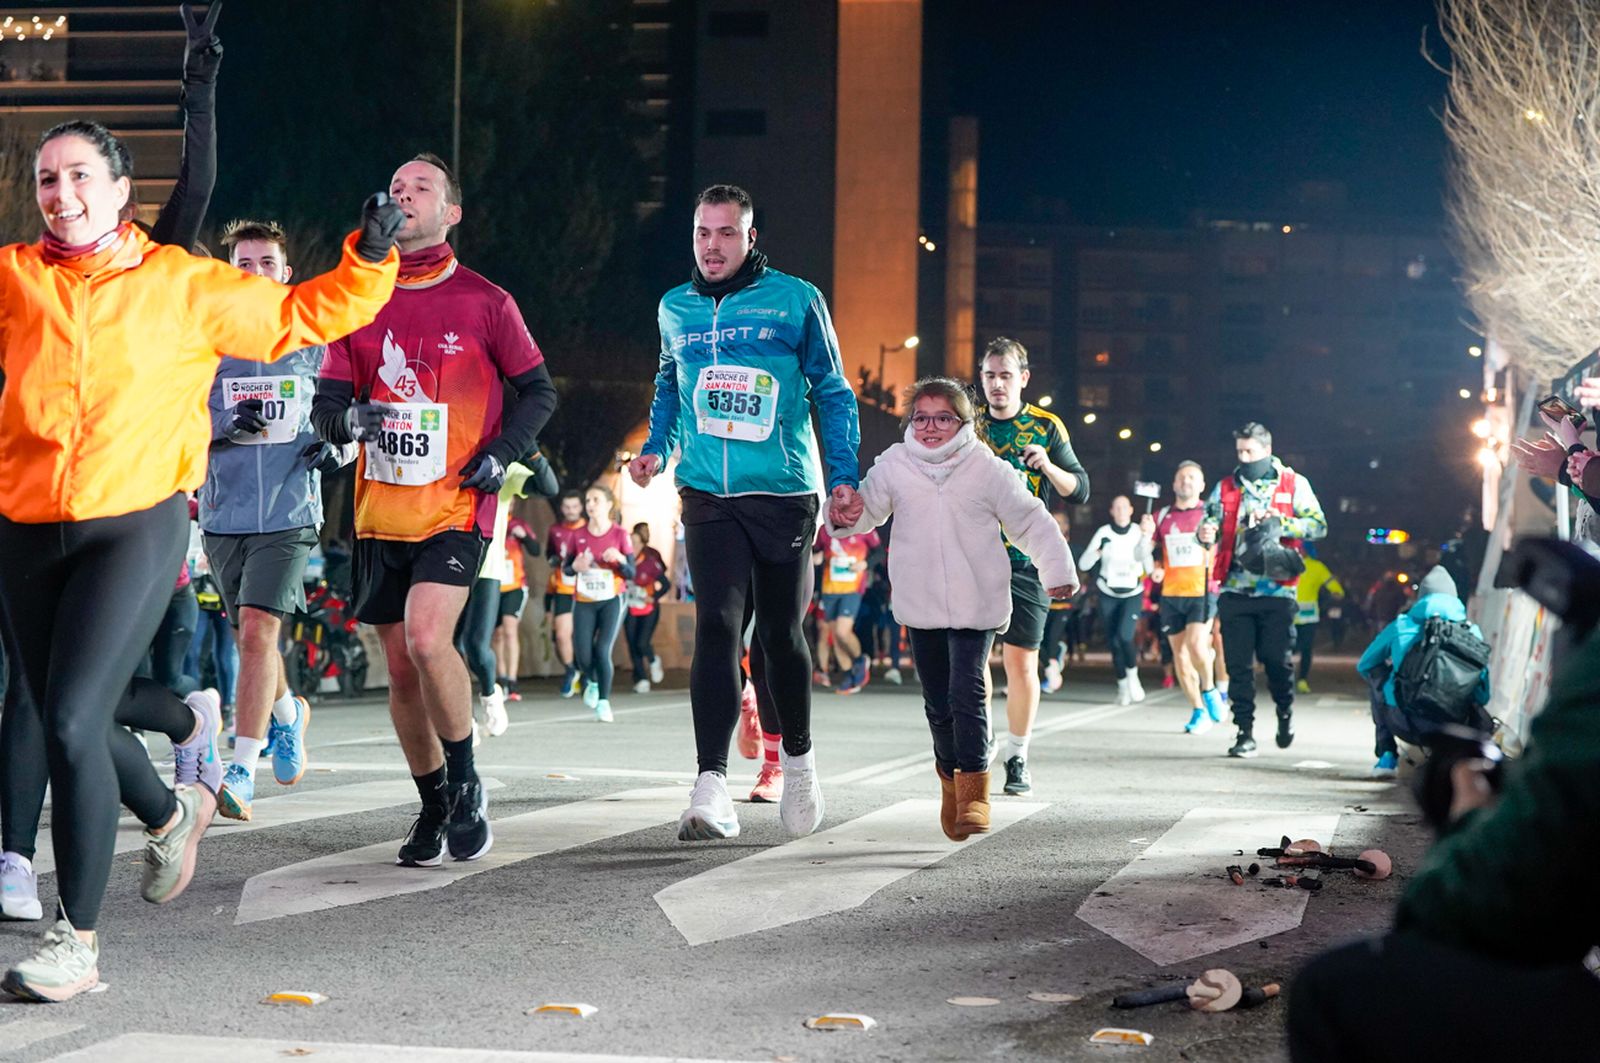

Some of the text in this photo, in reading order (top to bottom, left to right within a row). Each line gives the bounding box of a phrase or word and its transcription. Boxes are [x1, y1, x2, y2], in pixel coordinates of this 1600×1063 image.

[714, 373, 738, 381] NOCHE
[739, 374, 749, 382] DE
[241, 384, 263, 392] NOCHE
[264, 383, 273, 391] DE
[394, 375, 416, 397] 43
[705, 382, 720, 390] SAN
[232, 393, 247, 401] SAN
[708, 391, 762, 417] 5353
[265, 400, 286, 420] 07
[402, 412, 412, 420] DE
[377, 430, 429, 457] 4863
